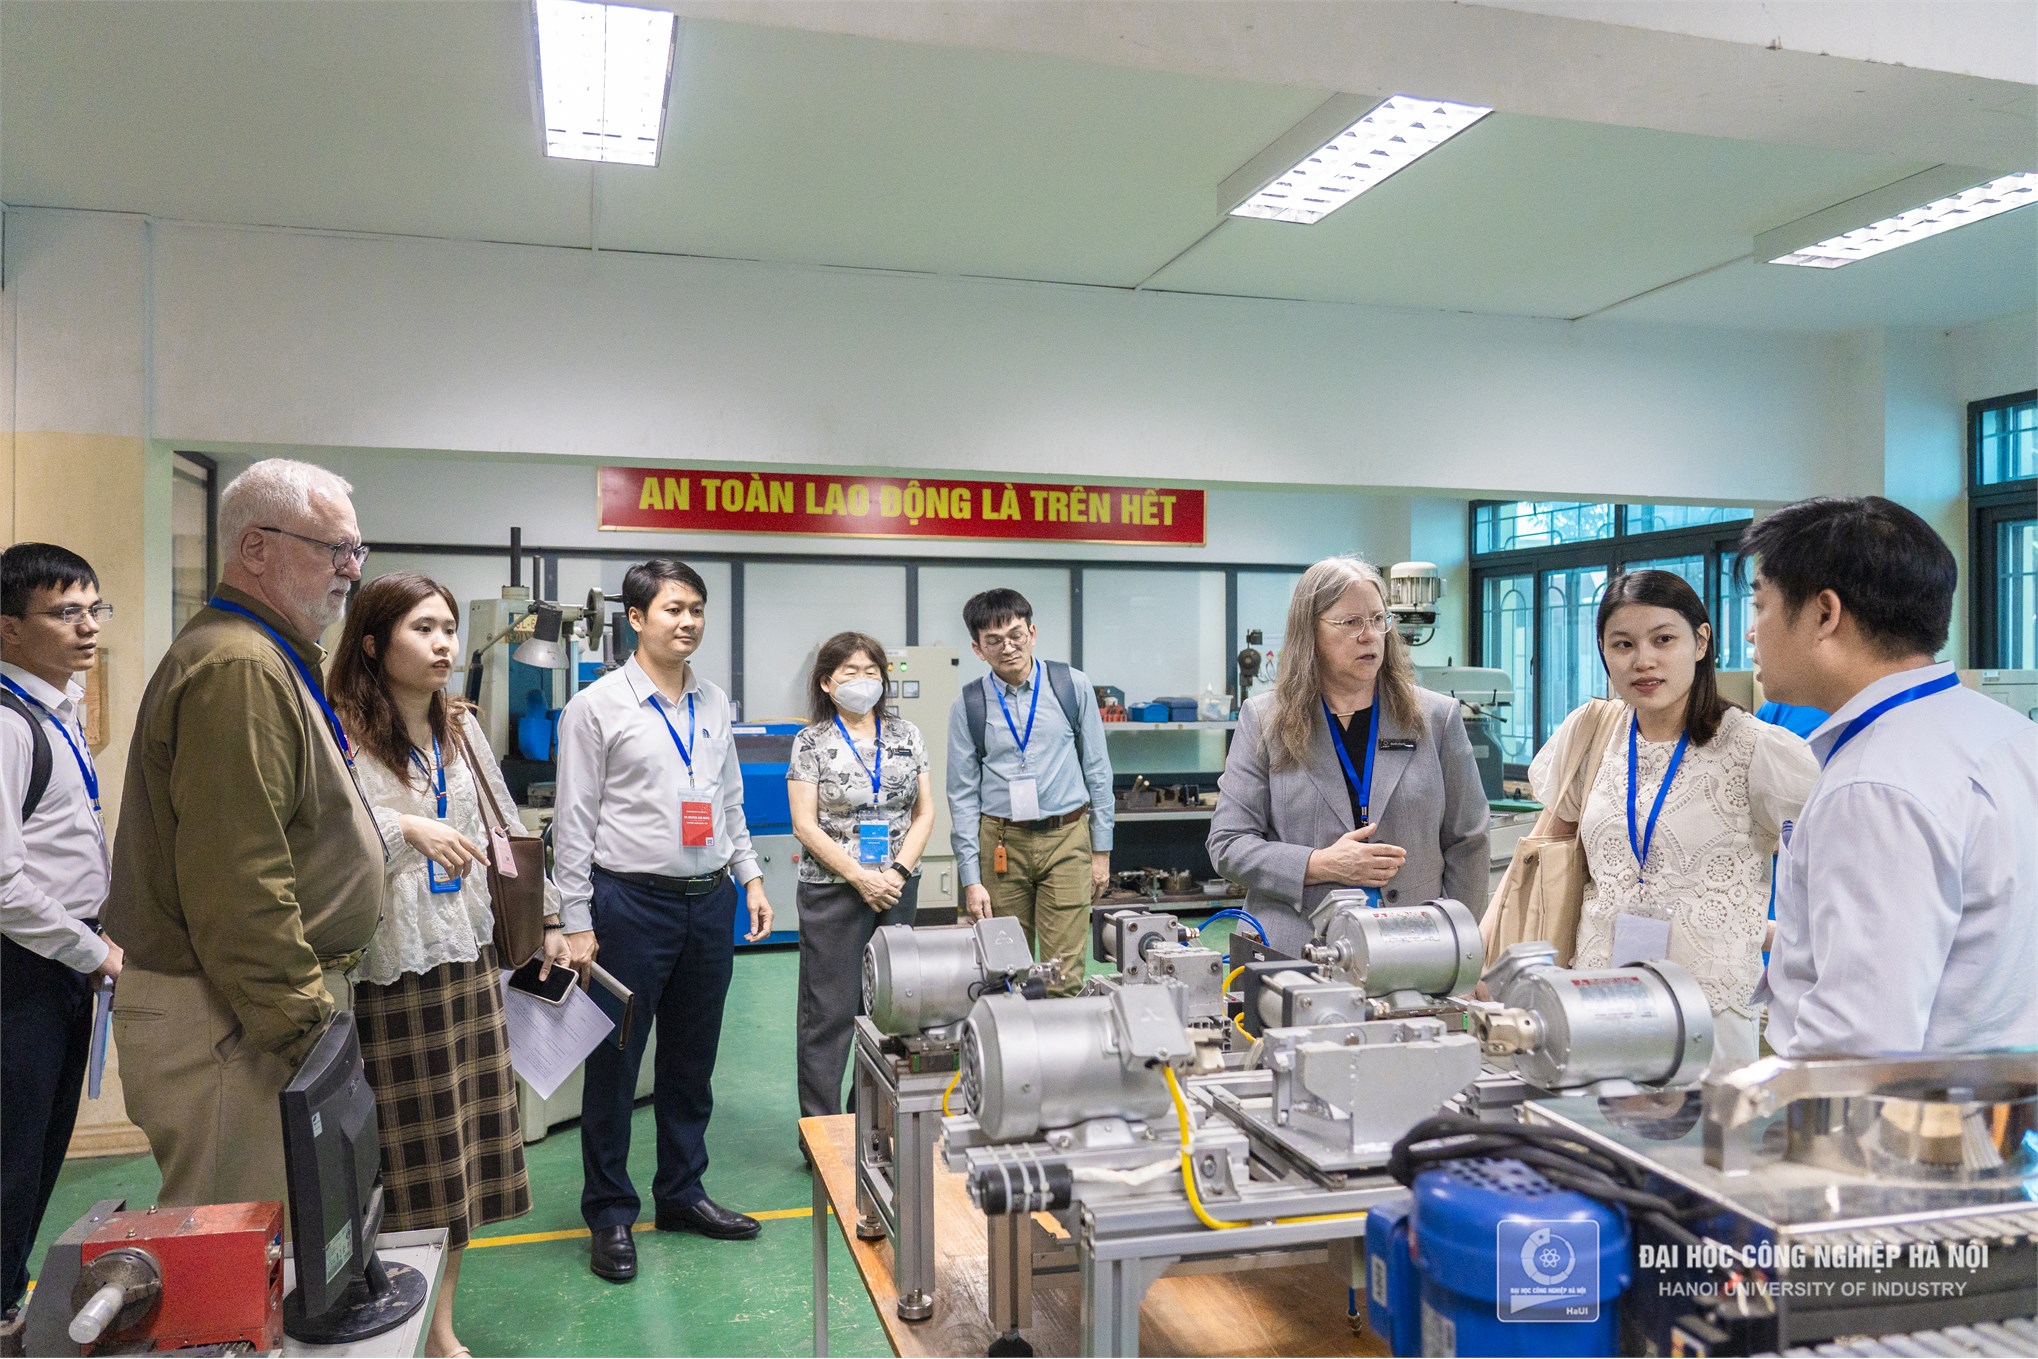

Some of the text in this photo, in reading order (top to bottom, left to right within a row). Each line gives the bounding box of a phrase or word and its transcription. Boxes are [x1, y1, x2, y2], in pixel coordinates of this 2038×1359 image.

[639, 473, 1177, 526] AN TOÀN LAO ĐỘNG LÀ TRÊN HẾT
